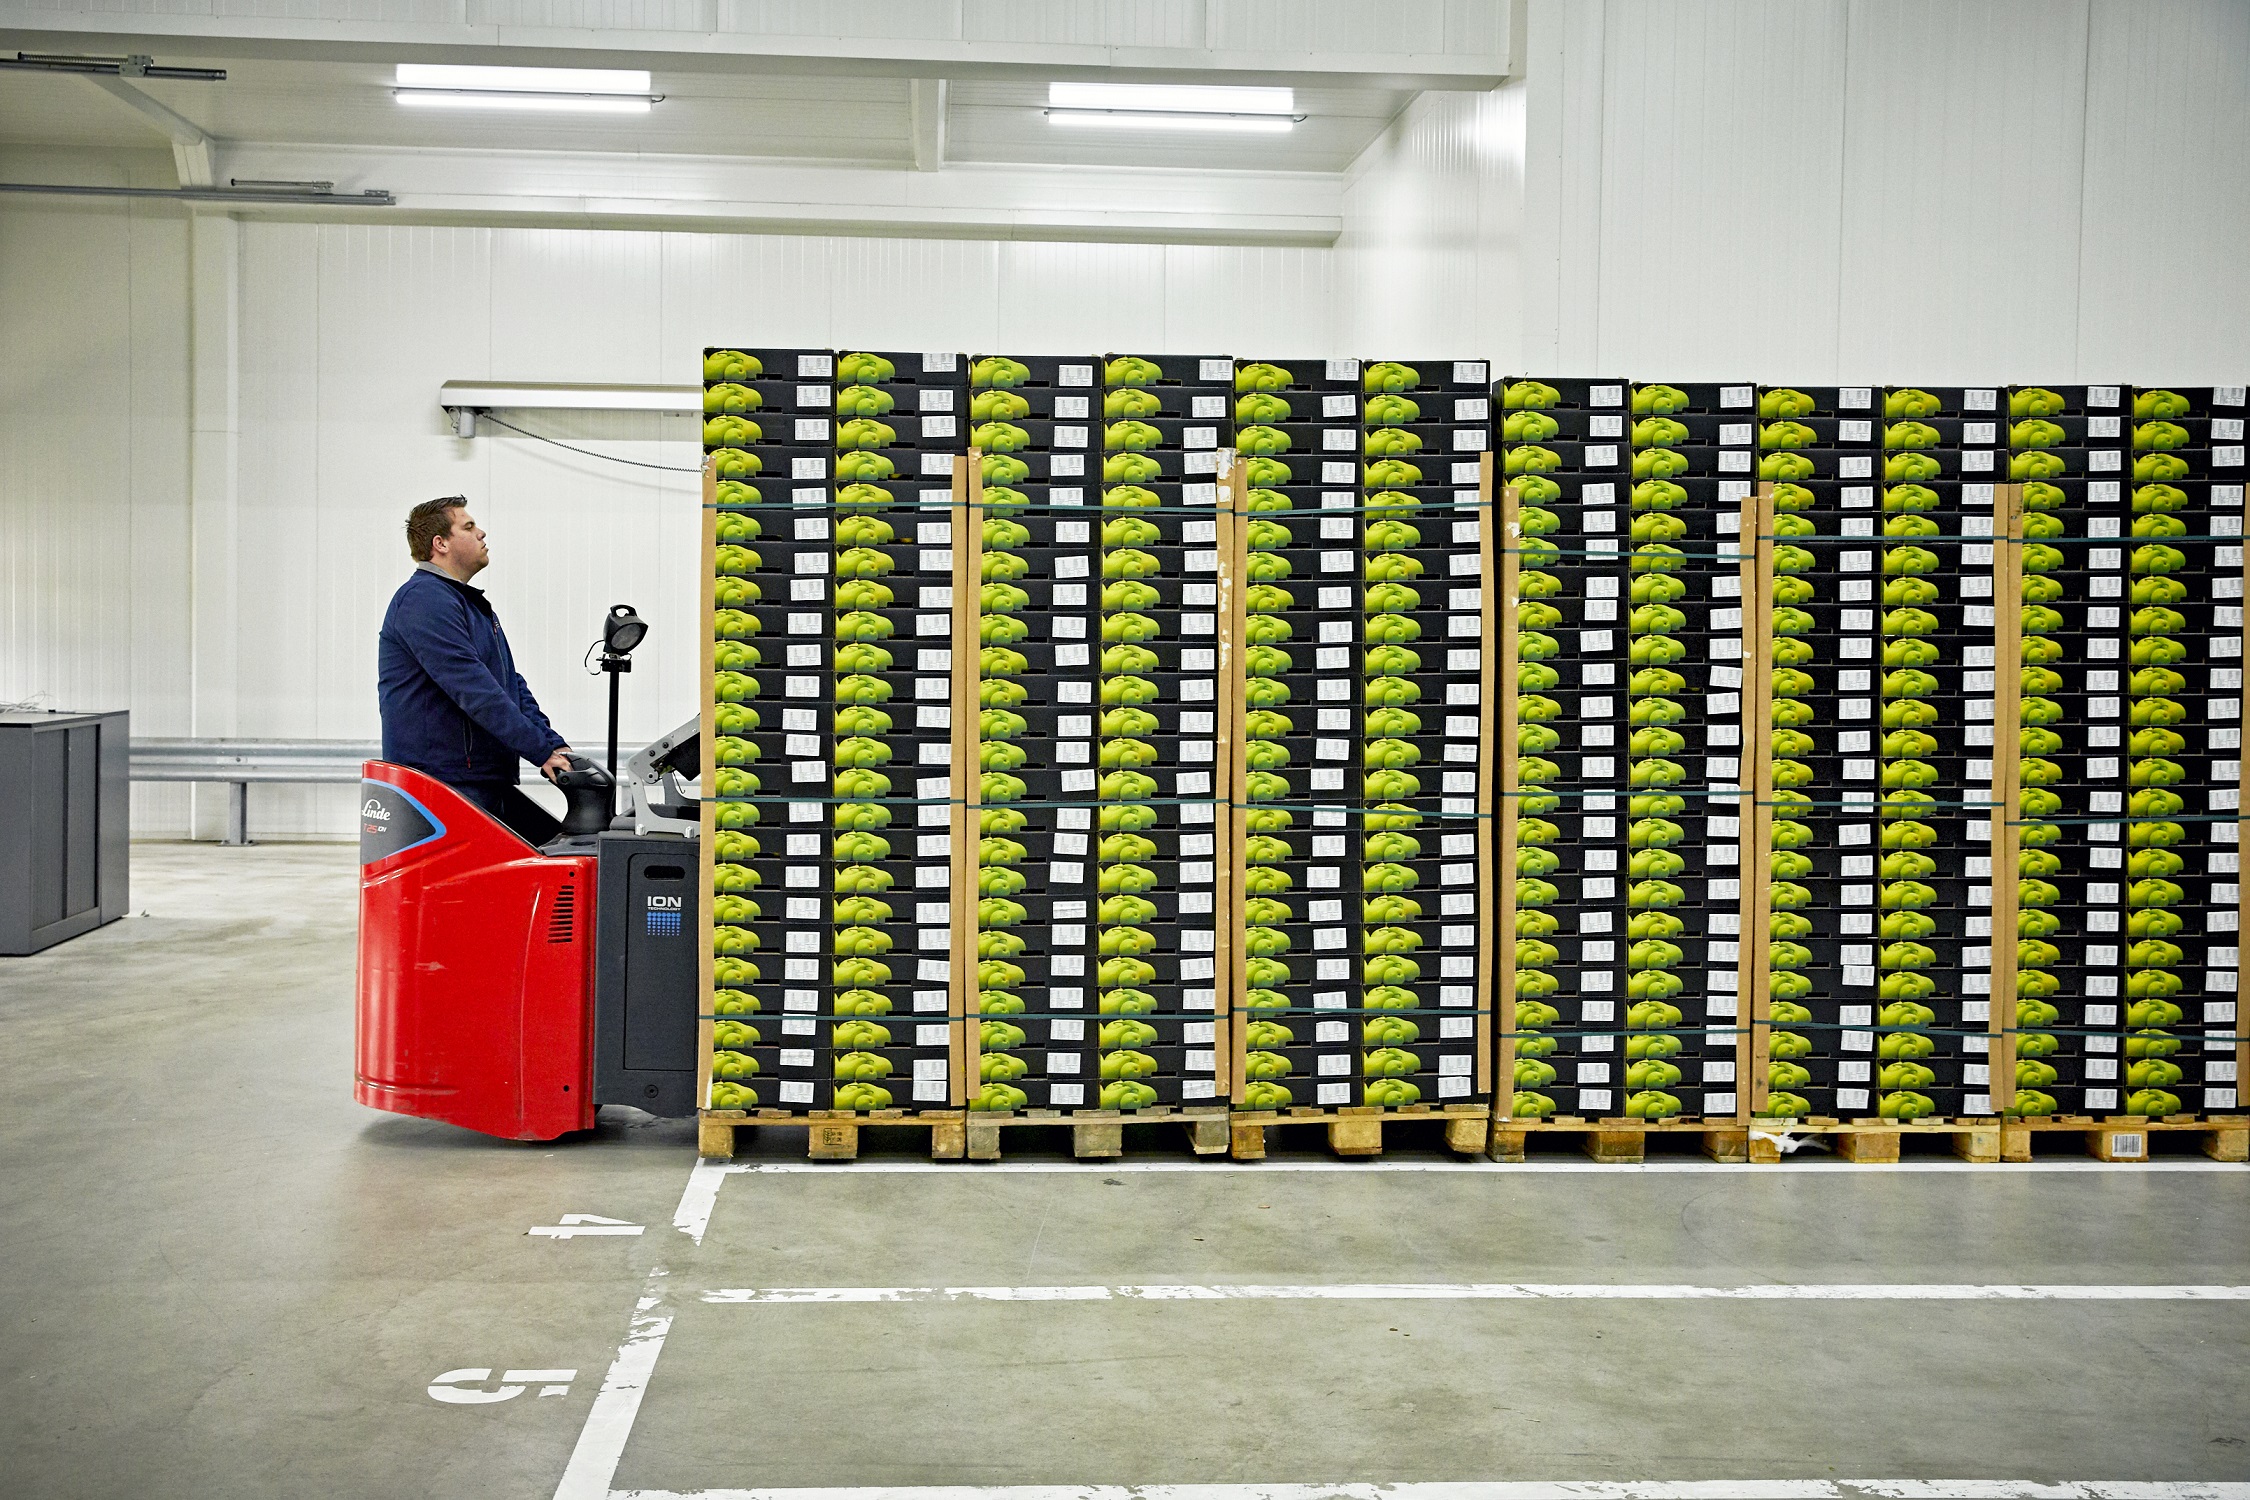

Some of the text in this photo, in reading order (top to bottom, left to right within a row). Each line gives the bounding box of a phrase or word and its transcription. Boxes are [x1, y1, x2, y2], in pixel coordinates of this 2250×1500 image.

[362, 799, 390, 820] Linde
[648, 896, 681, 907] ION
[527, 1213, 645, 1239] 4
[427, 1368, 578, 1404] 5
